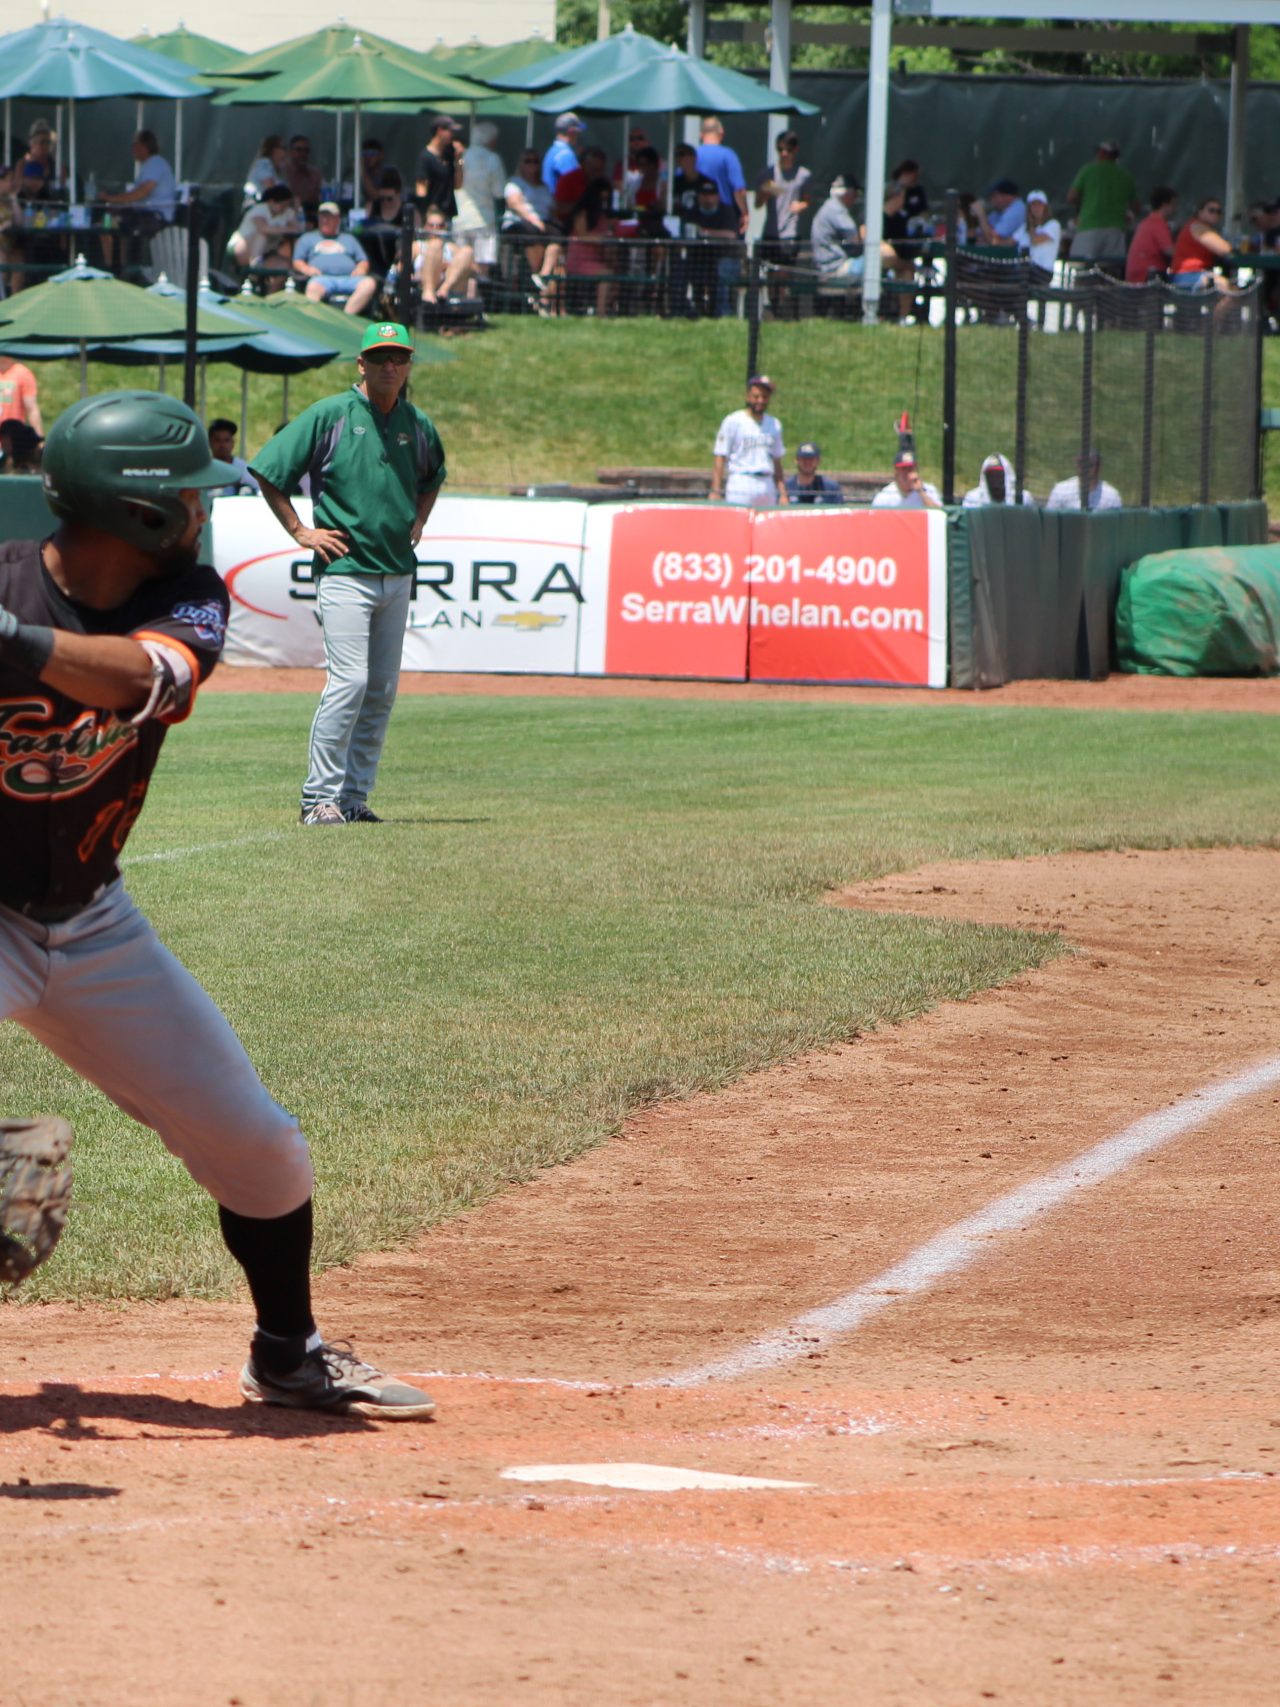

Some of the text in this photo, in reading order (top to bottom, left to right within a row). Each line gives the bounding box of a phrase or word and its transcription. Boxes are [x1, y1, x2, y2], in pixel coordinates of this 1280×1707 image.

[289, 560, 585, 603] SRRA
[652, 551, 897, 588] (833) 201-4900
[621, 592, 923, 631] SerraWhelan.com
